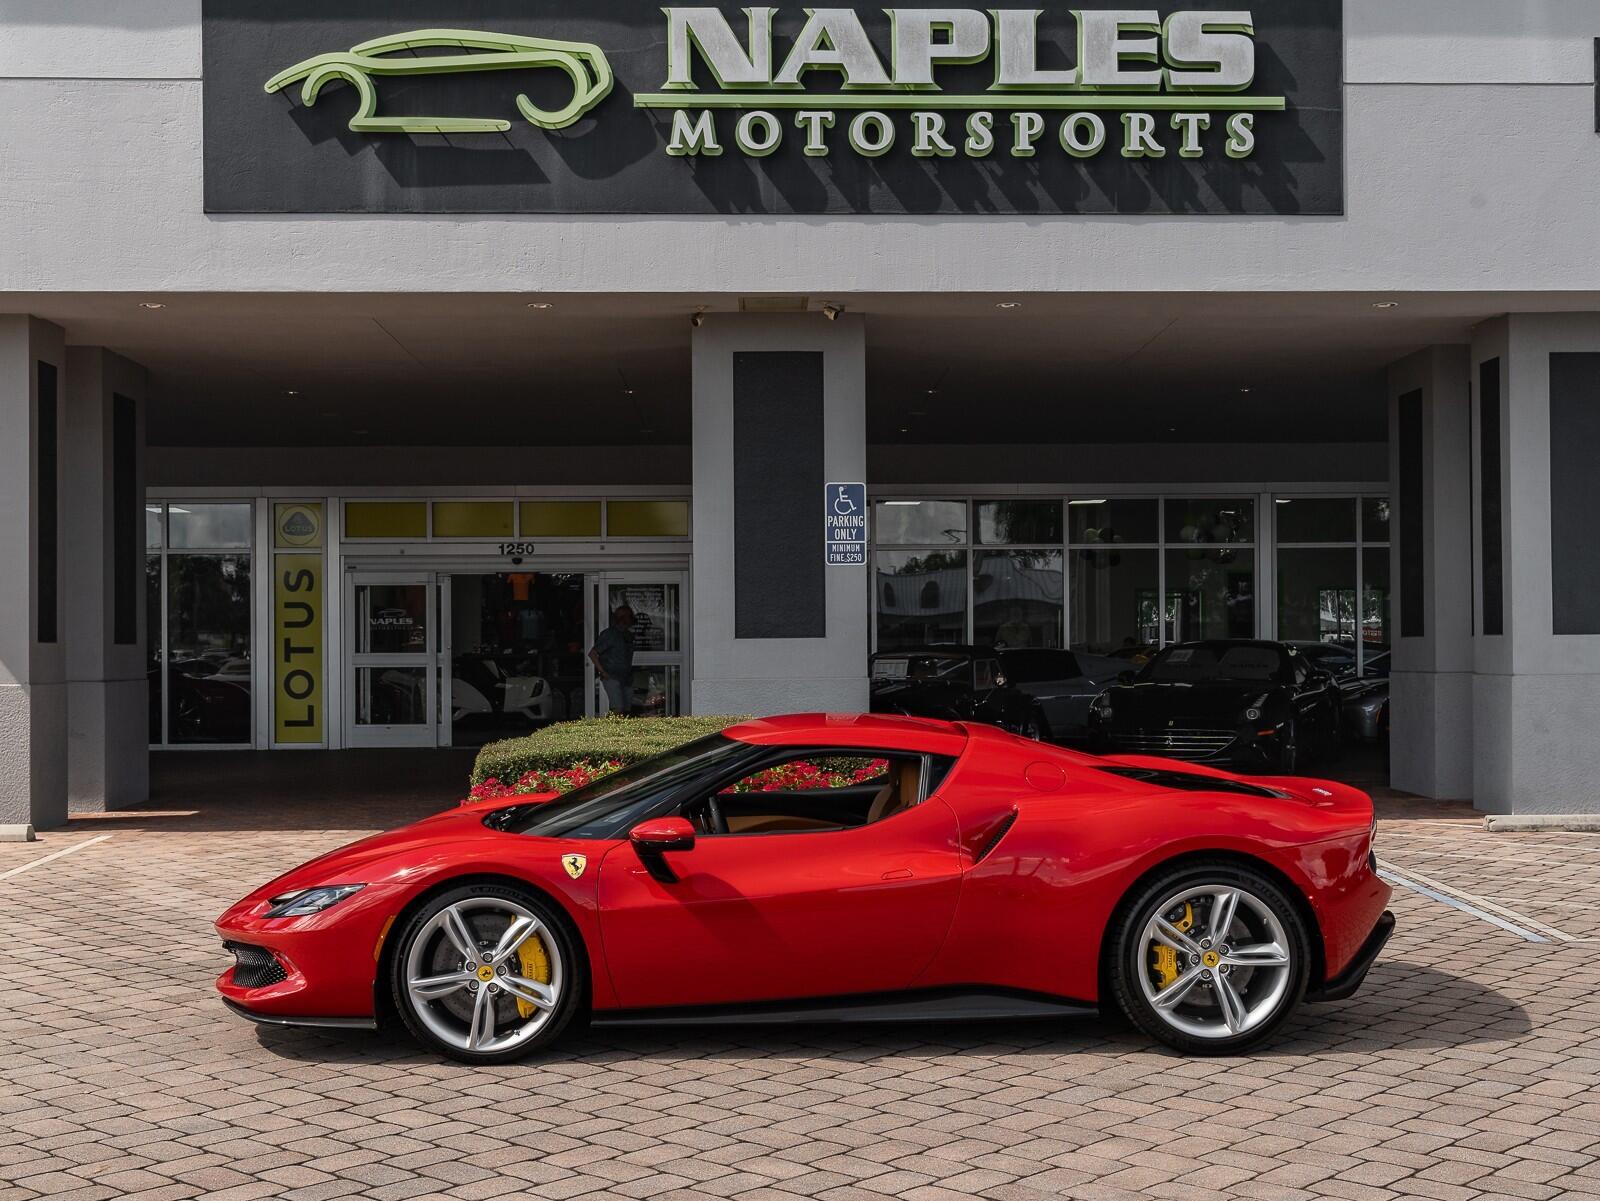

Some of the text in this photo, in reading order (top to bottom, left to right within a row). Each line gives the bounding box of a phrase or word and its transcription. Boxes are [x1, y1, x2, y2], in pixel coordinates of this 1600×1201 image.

[662, 7, 1256, 91] NAPLES
[666, 110, 1256, 158] MOTORSPORTS
[827, 515, 864, 527] PARKING
[834, 528, 857, 540] ONLY
[498, 543, 535, 555] 1250
[832, 544, 860, 552] MINIMUM
[830, 553, 862, 562] FINE $250
[284, 569, 314, 727] LOTUS
